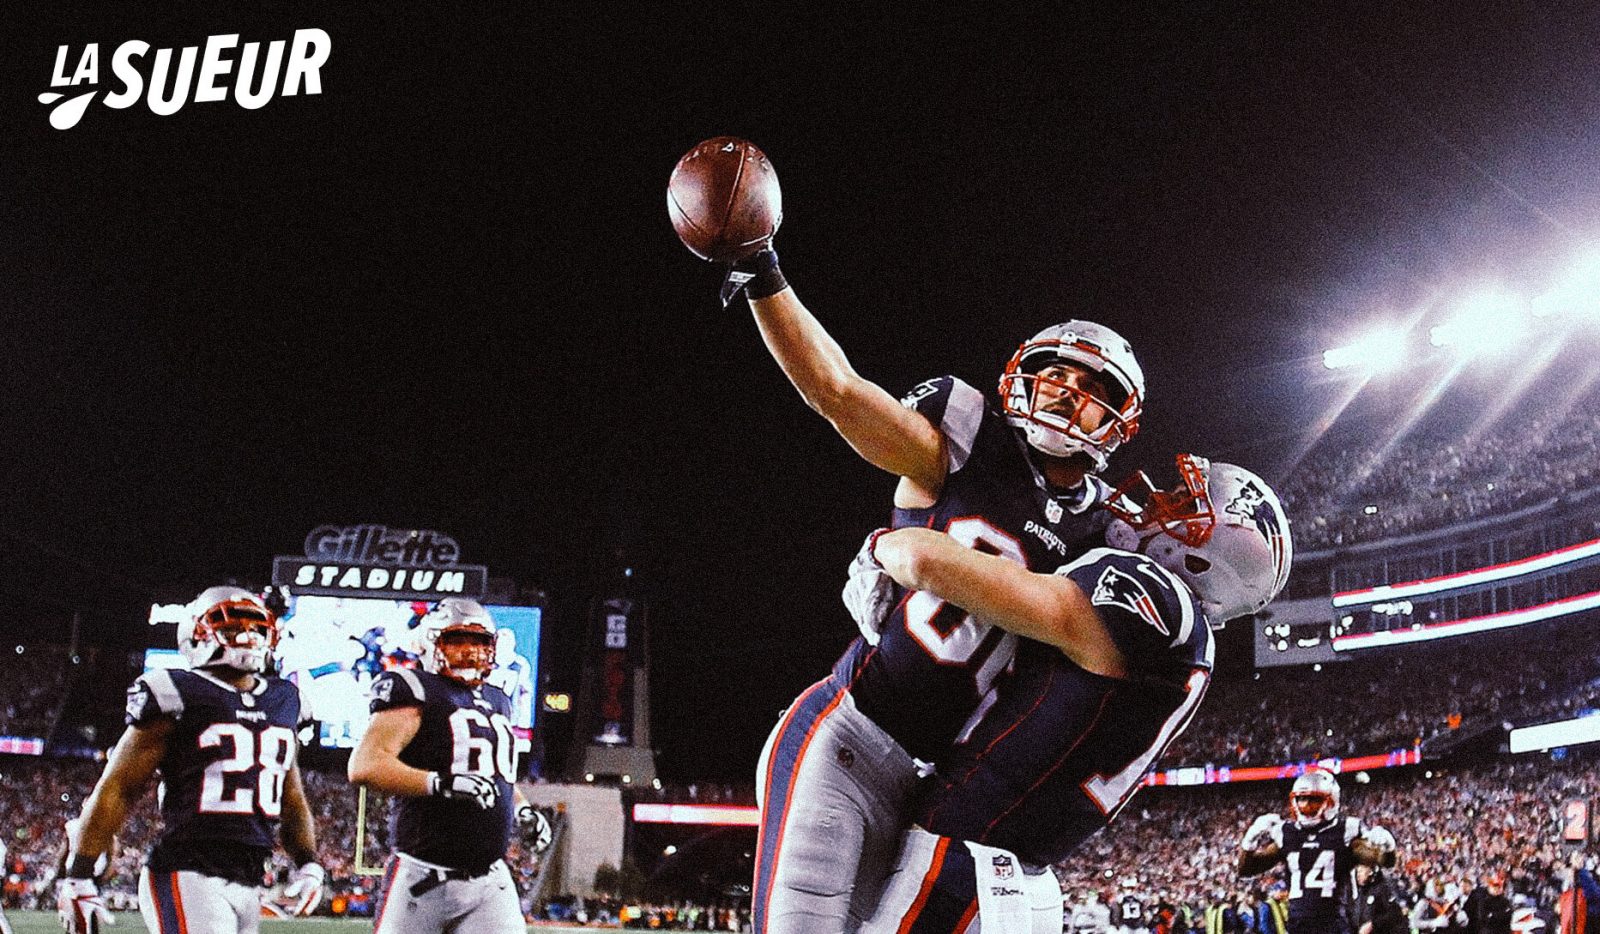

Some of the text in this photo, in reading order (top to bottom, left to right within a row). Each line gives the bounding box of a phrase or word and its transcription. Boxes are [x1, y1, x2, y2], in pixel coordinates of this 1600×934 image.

[305, 524, 459, 567] Gillette
[1023, 520, 1067, 556] PATRIOTS
[295, 565, 464, 592] STADIUM
[448, 707, 519, 784] 60
[198, 722, 296, 816] 28
[1286, 850, 1337, 899] 14
